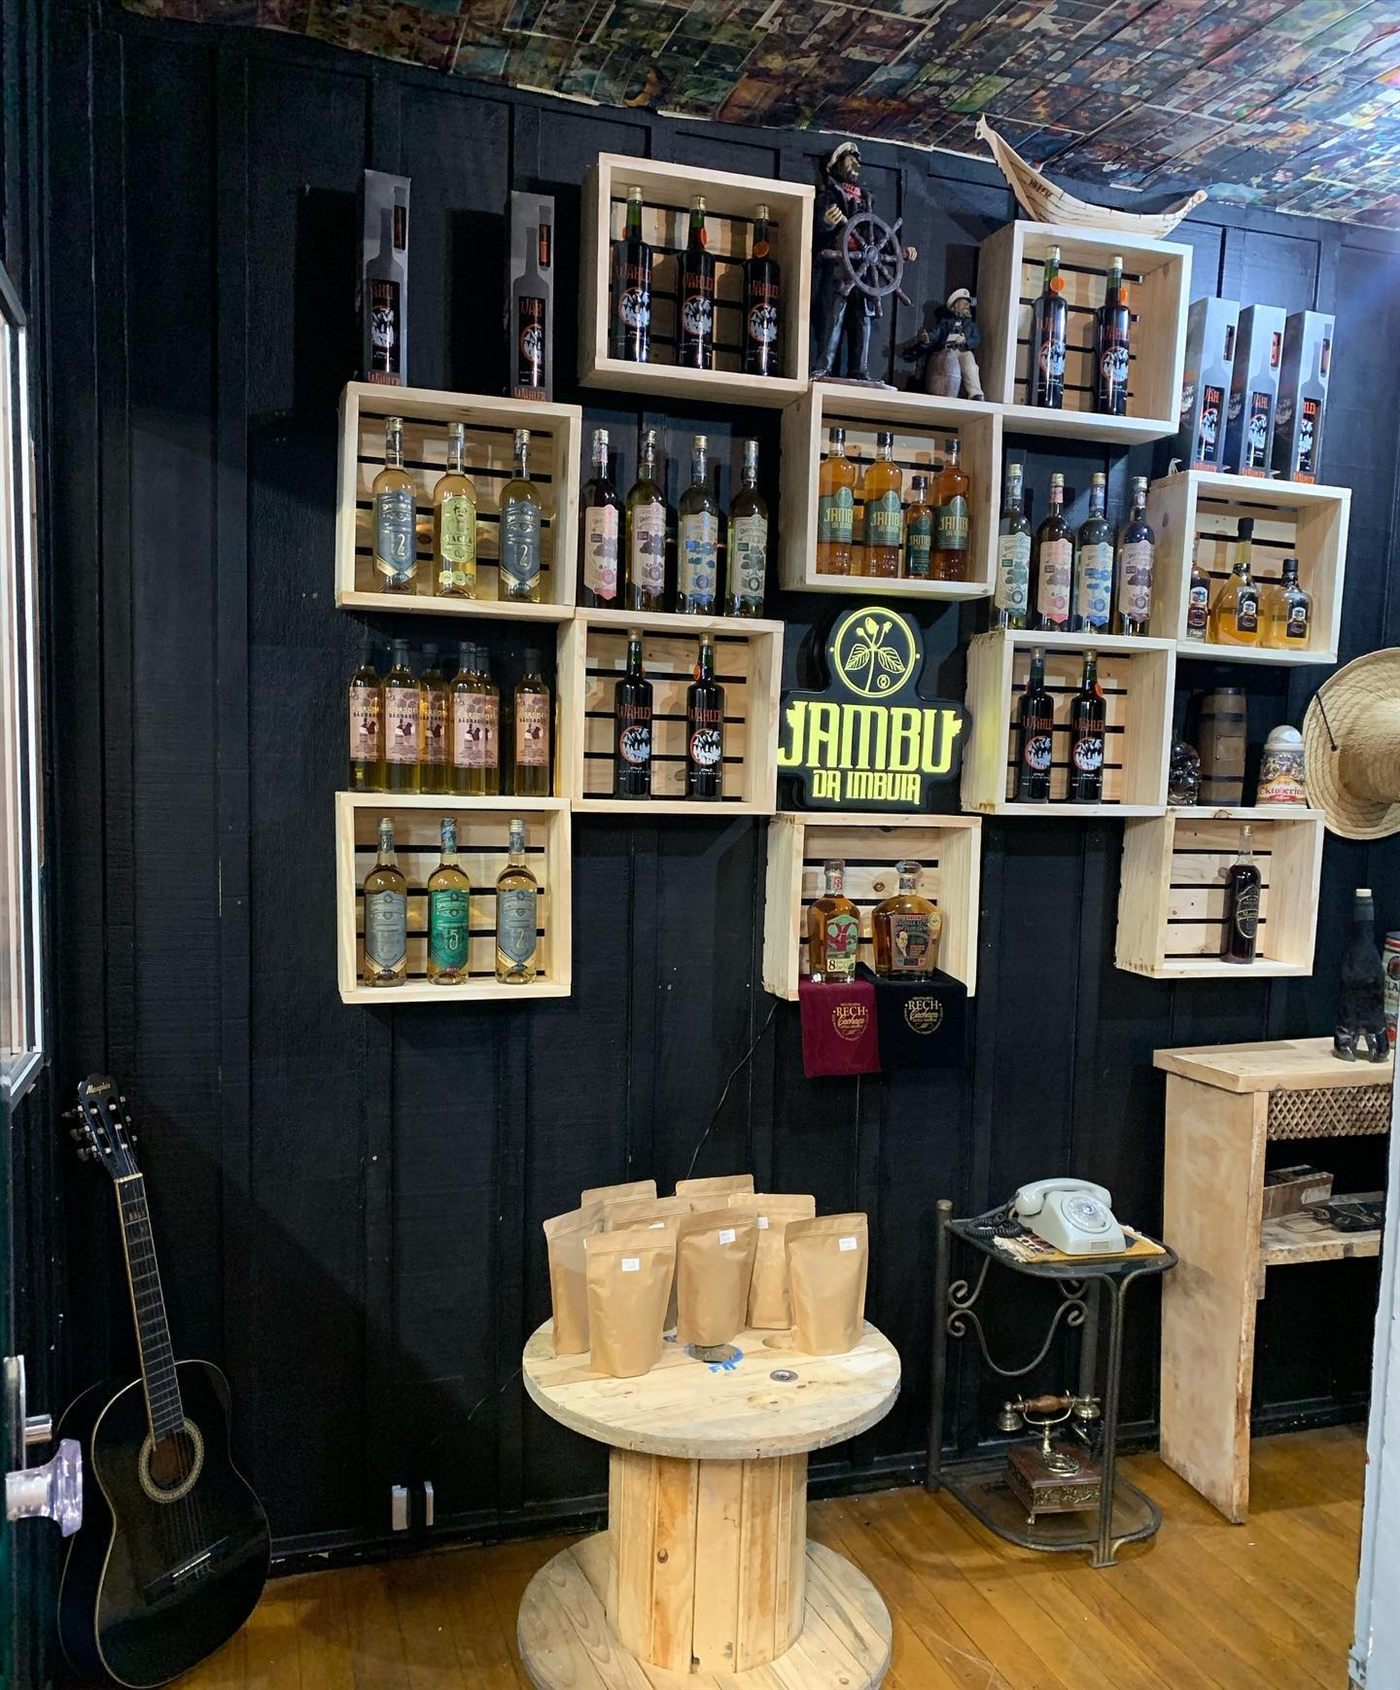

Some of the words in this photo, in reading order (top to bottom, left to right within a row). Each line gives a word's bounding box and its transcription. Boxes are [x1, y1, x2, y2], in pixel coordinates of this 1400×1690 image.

[777, 701, 962, 773] JAMBU
[812, 769, 841, 802] DA
[846, 771, 921, 805] IMBUIA
[828, 959, 836, 971] 8
[836, 1006, 866, 1016] RECH
[908, 1000, 939, 1010] RECH
